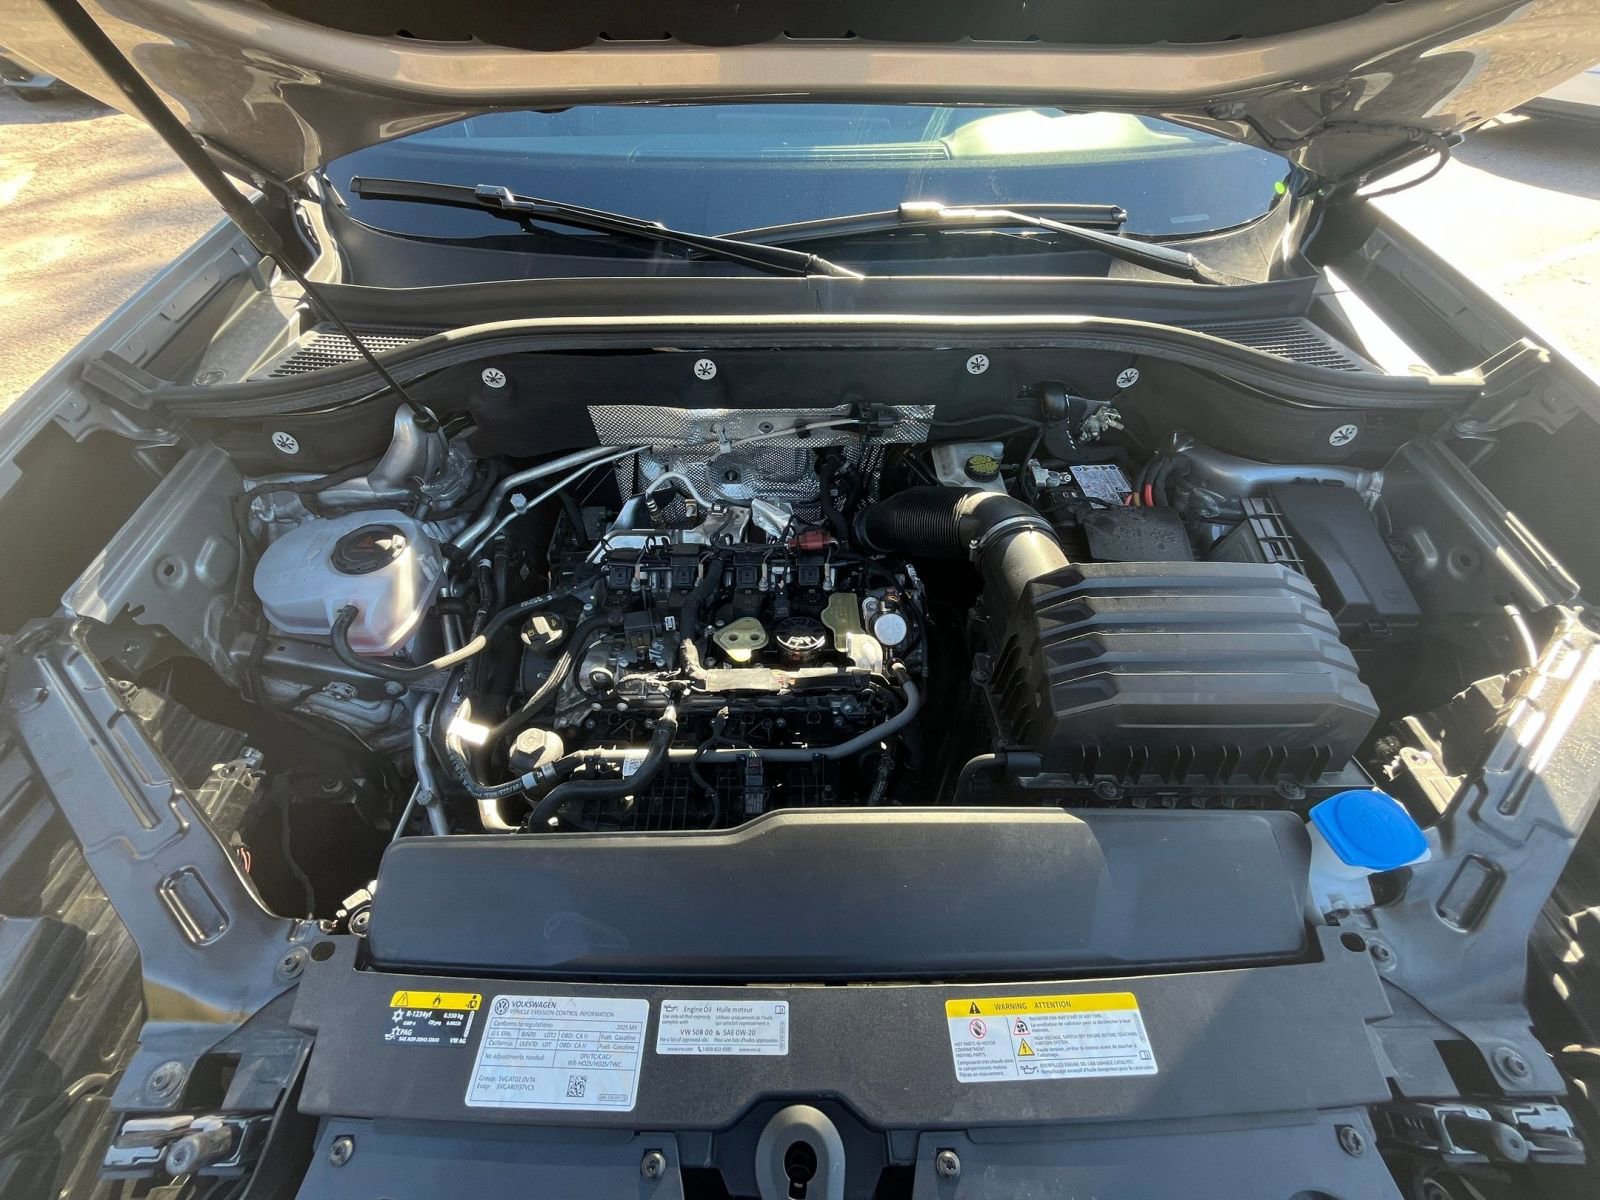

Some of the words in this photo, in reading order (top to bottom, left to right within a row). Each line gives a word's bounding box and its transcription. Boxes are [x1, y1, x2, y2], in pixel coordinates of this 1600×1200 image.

[511, 1000, 557, 1009] VOLKSWAGEN
[993, 1002, 1028, 1011] WARNING
[1034, 1000, 1072, 1009] ATTENTION
[683, 1006, 702, 1014] Engine
[400, 1028, 413, 1036] PAG
[612, 1043, 635, 1051] Gasoline
[493, 1053, 525, 1061] adjustments
